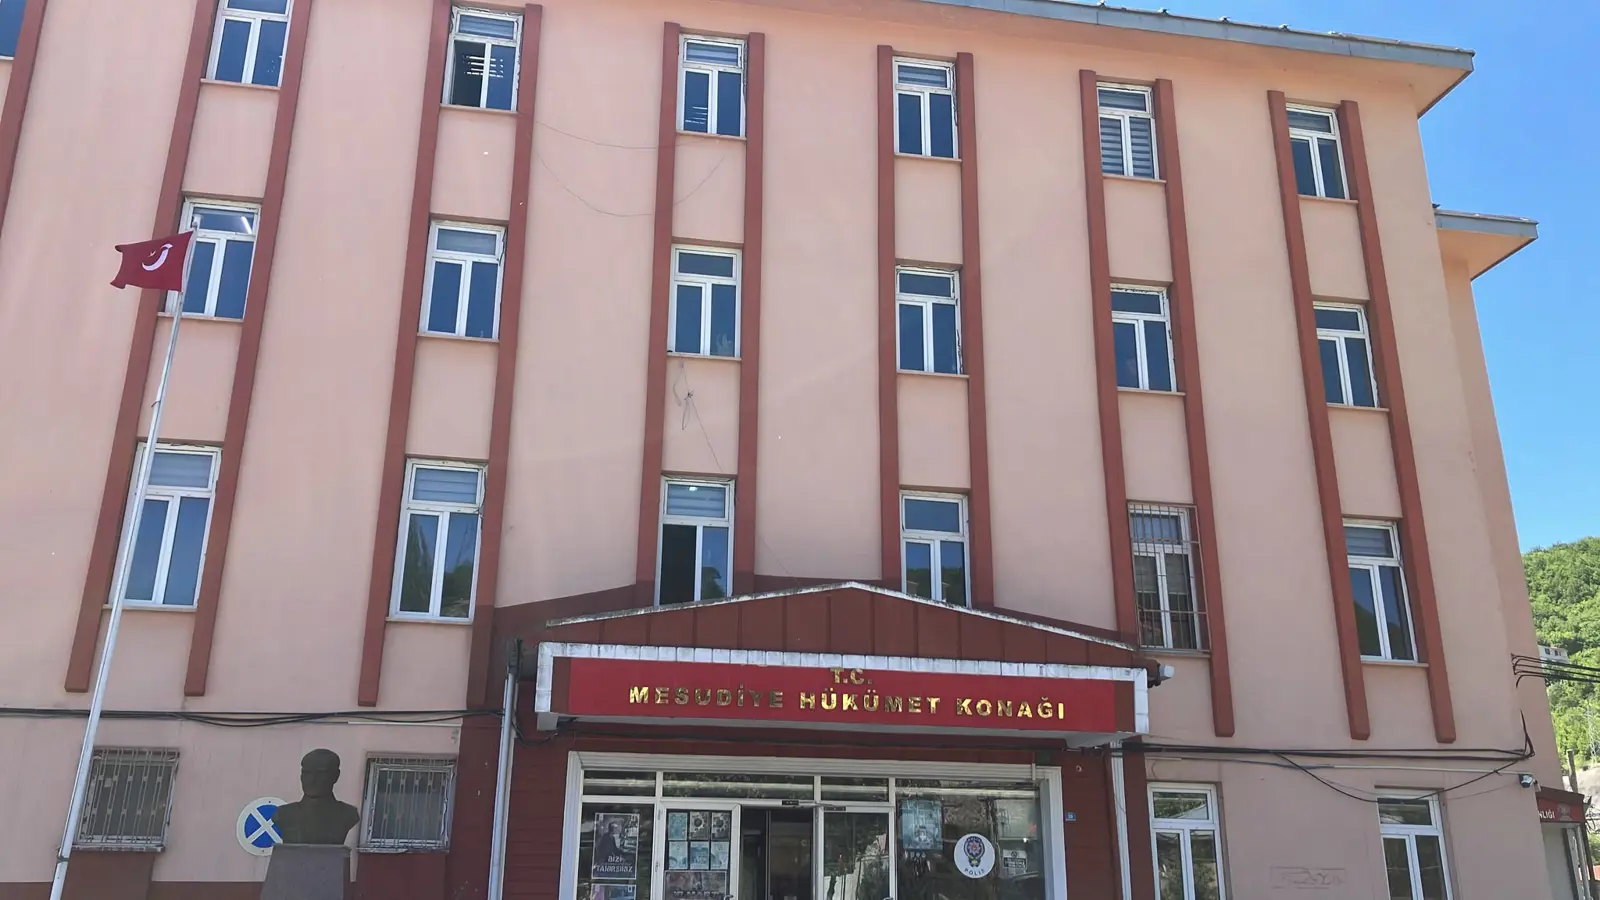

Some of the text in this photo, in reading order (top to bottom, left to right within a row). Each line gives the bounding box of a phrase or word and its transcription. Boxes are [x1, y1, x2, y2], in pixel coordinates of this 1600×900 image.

[830, 667, 872, 685] T.C.
[629, 684, 1065, 720] MESUDİYE HÜKÜMET KONAĞI
